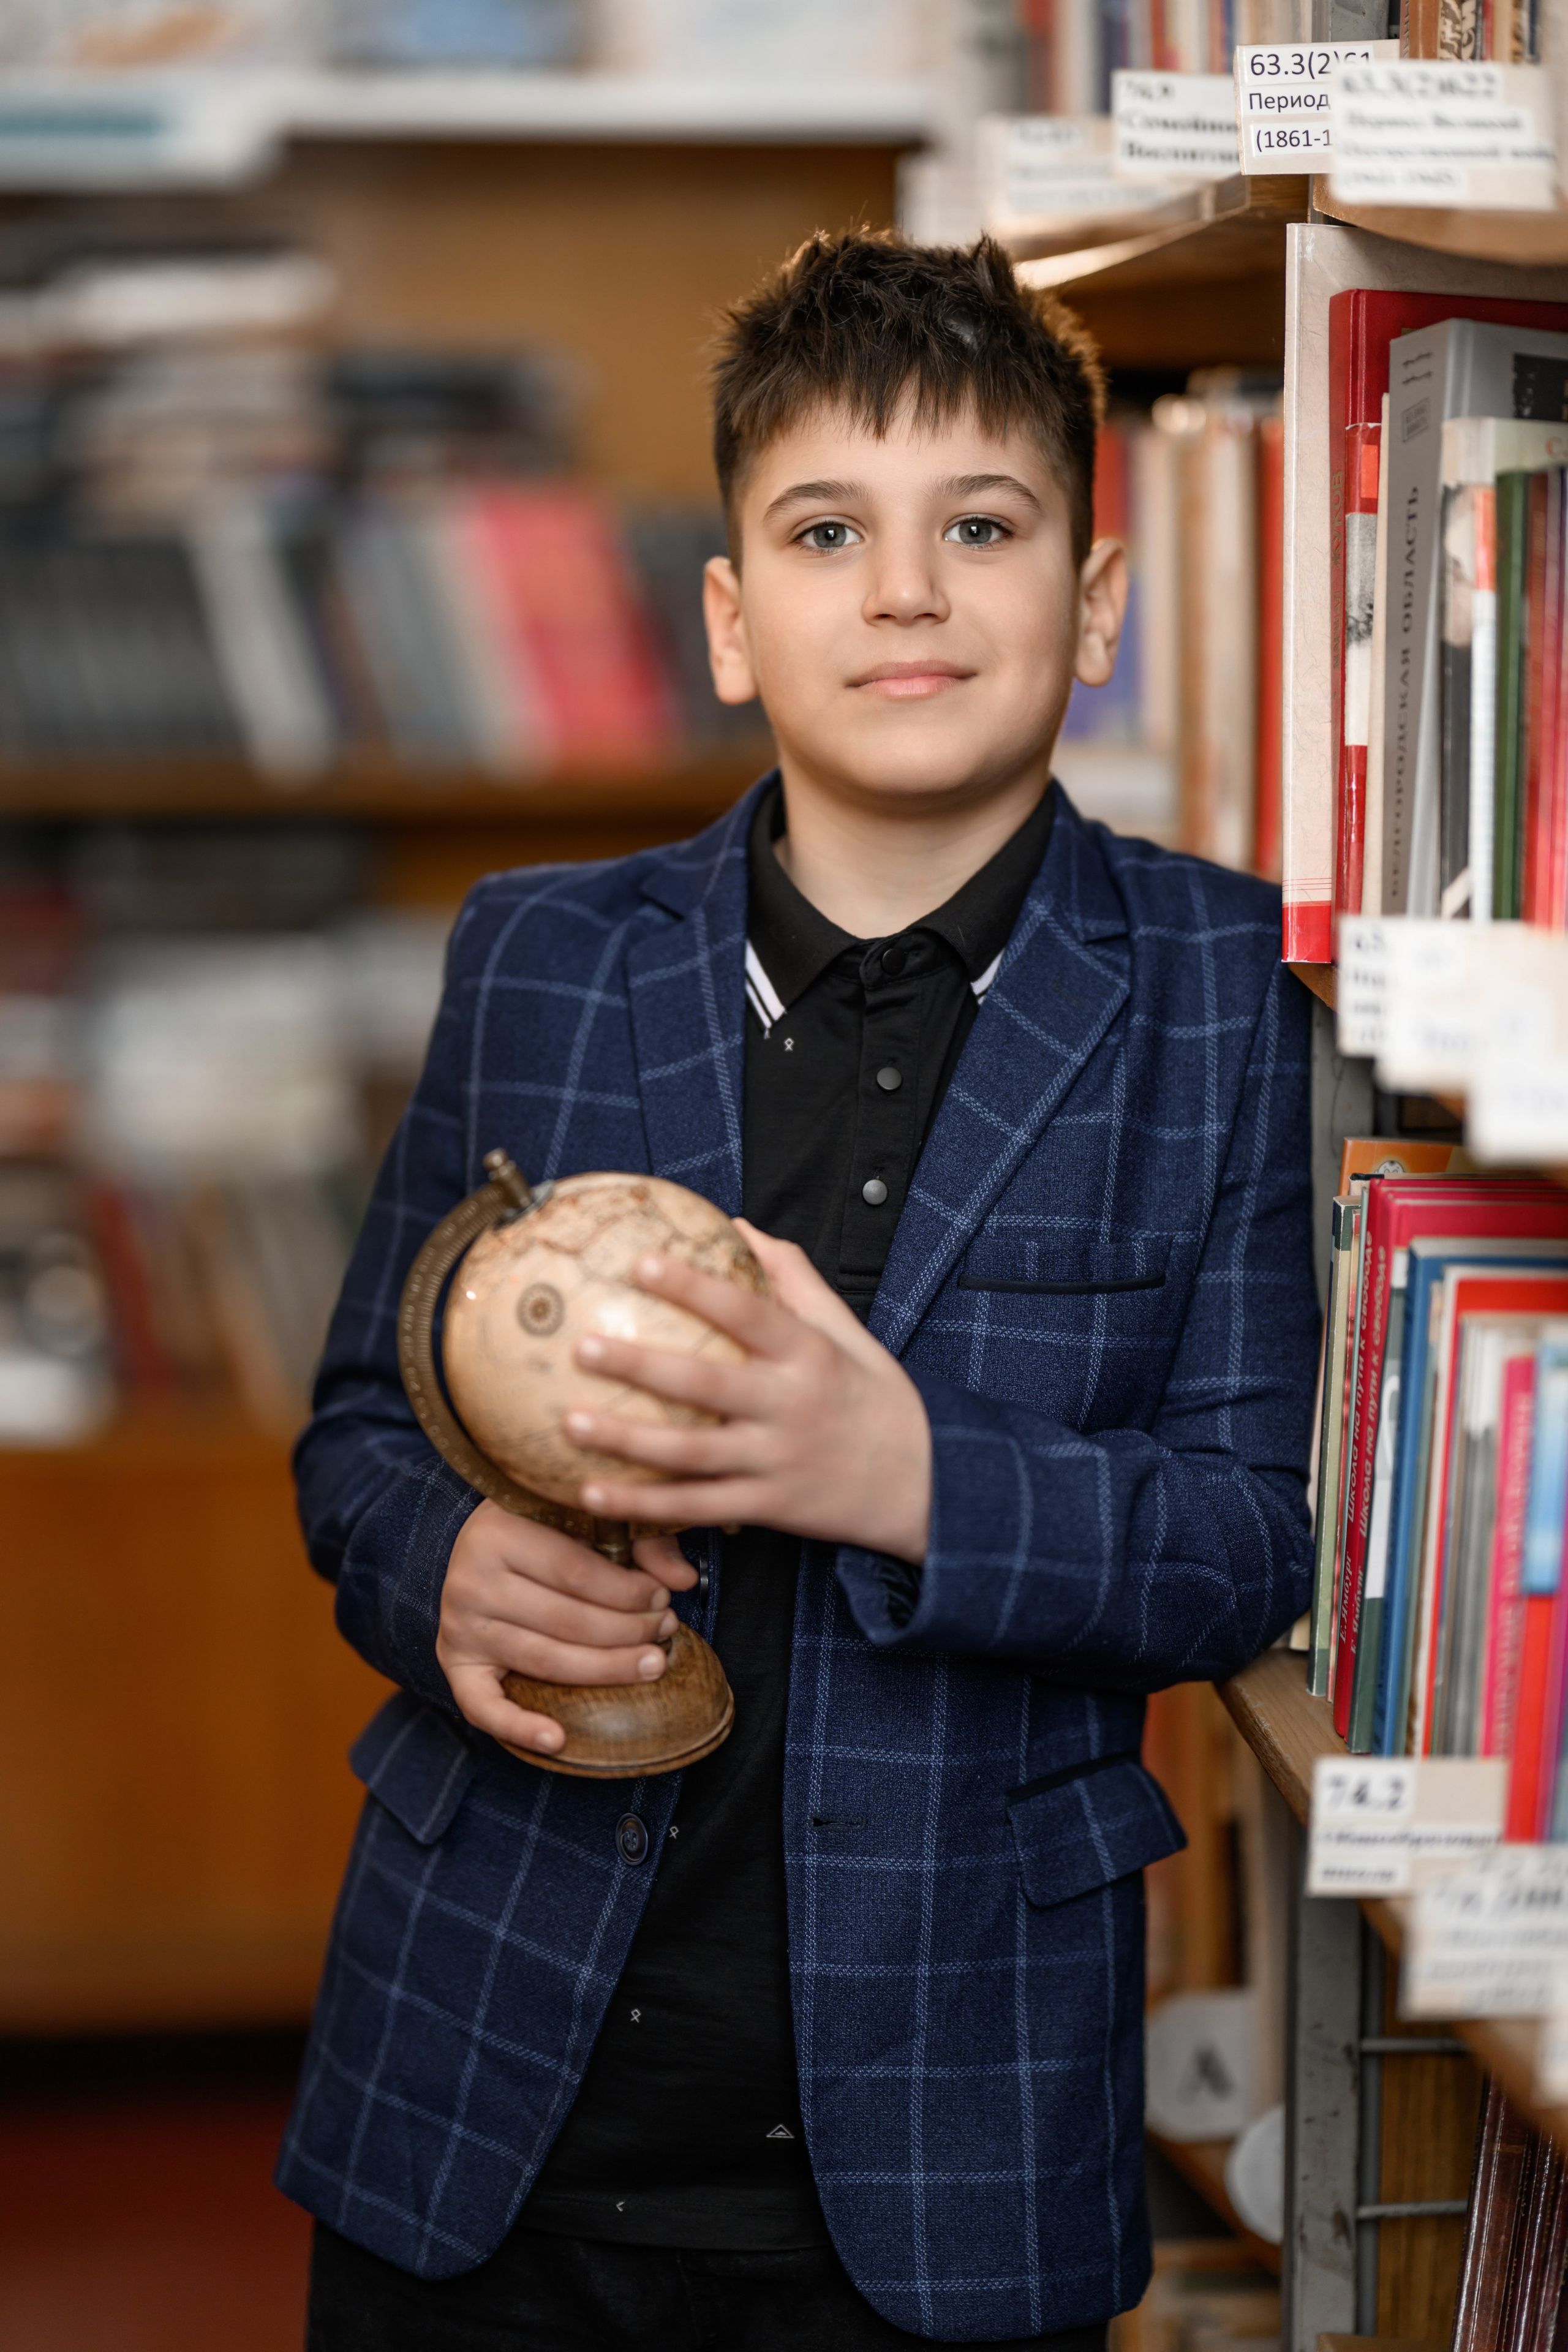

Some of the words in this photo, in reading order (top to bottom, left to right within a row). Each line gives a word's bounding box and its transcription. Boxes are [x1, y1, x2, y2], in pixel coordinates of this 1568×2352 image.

[1249, 93, 1331, 113] Период
[1332, 470, 1343, 569] ЖУКОВ
[1401, 486, 1419, 633] ОБЛАСТЬ
[1332, 591, 1341, 669] МАРШАЛ
[1361, 1231, 1373, 1330] свободе
[1373, 1245, 1387, 1346] свободе
[1360, 1336, 1366, 1351] к
[1371, 1349, 1379, 1366] к
[1356, 1355, 1365, 1406] пути
[1368, 1369, 1379, 1422] пути
[1355, 1409, 1361, 1439] на
[1366, 1425, 1374, 1455] на
[1348, 1444, 1359, 1523] Школа
[1359, 1459, 1372, 1537] Школа
